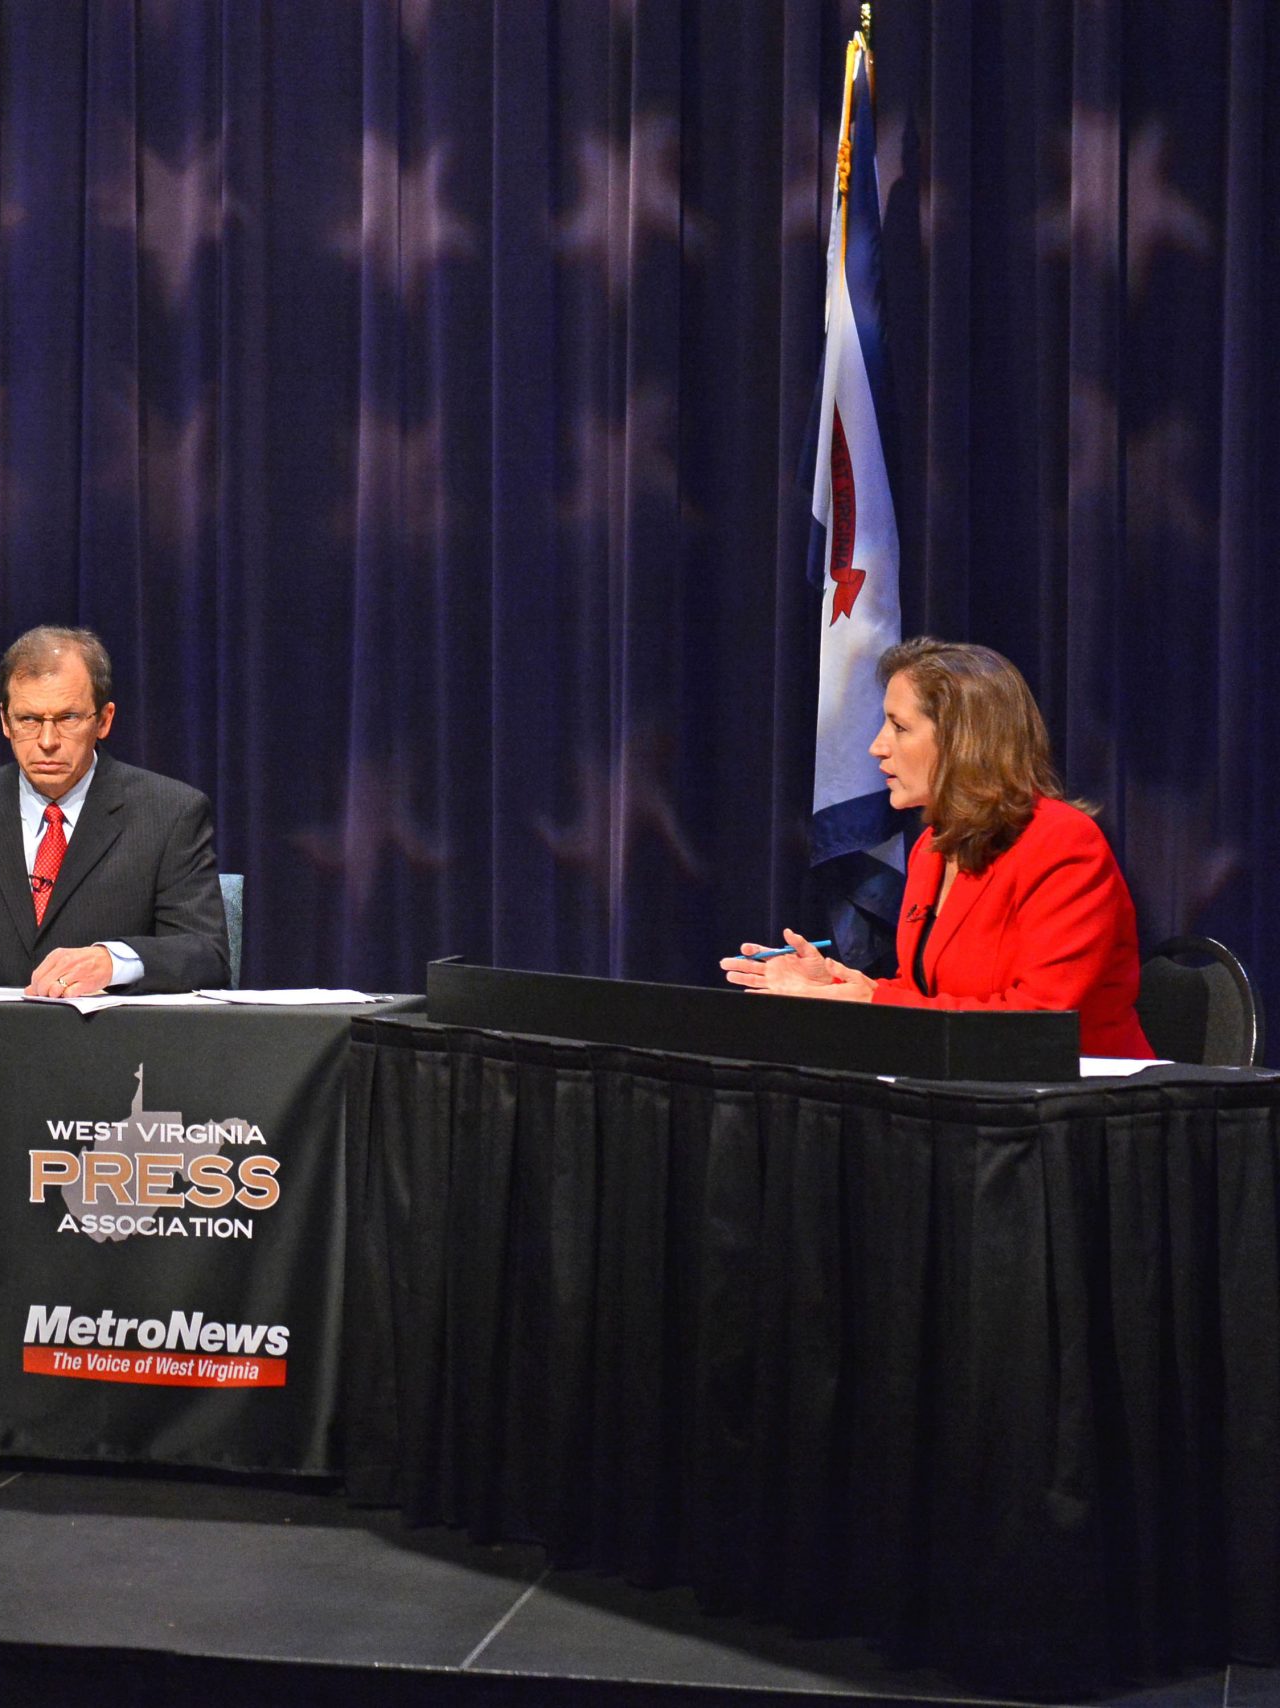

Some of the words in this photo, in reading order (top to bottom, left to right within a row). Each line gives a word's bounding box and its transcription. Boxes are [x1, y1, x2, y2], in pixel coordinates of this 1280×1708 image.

[47, 1121, 128, 1142] WEST
[136, 1122, 267, 1145] VIRGINIA
[29, 1150, 280, 1210] PRESS
[57, 1214, 253, 1239] ASSOCIATION
[23, 1305, 290, 1356] MetroNews
[53, 1352, 82, 1370] The
[86, 1353, 131, 1373] Voice
[134, 1356, 154, 1374] of
[155, 1357, 195, 1377] West
[197, 1359, 260, 1382] Virginia
